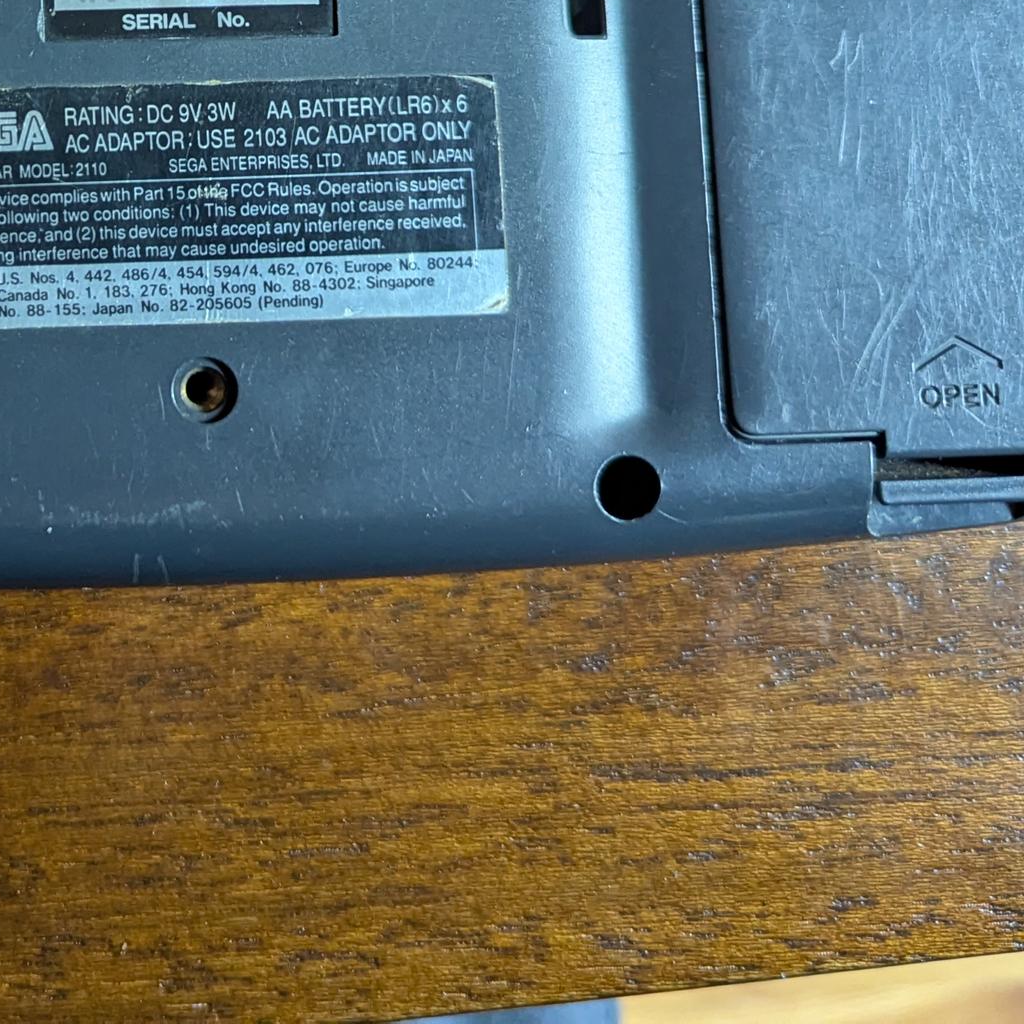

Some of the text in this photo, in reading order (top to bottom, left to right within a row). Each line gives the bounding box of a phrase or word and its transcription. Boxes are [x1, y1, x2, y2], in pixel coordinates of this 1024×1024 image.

[122, 11, 250, 30] SERIAL No.
[147, 104, 173, 123] DC
[179, 103, 201, 122] 9V
[208, 101, 236, 121] 3W
[267, 100, 292, 120] AA
[65, 134, 89, 153] AC
[197, 129, 236, 149] USE
[244, 128, 287, 147] 2103
[295, 126, 320, 145] AC
[326, 123, 416, 144] ADAPTOR
[422, 121, 471, 140] ONLY
[169, 153, 345, 172] SEGA ENTERPRISES, LTD.
[367, 149, 474, 165] MADE IN JAPAN
[30, 188, 98, 208] complies
[100, 187, 130, 202] with
[134, 186, 164, 200] Part
[168, 185, 185, 199] 15
[231, 182, 264, 197] FCC
[268, 181, 315, 197] Rules.
[318, 179, 393, 197] Operation
[396, 179, 407, 192] is
[410, 176, 465, 197] subject
[63, 209, 89, 222] two
[180, 205, 200, 221] (1)
[204, 203, 236, 217] This
[240, 202, 289, 216] device
[295, 200, 326, 217] may
[331, 200, 355, 213] not
[359, 199, 404, 212] cause
[408, 196, 465, 210] harmful
[44, 226, 73, 242] and
[76, 226, 96, 243] (2)
[99, 226, 126, 240] this
[129, 223, 178, 238] device
[182, 223, 218, 237] must
[221, 221, 270, 238] accept
[274, 221, 299, 237] any
[304, 217, 394, 233] interference
[19, 247, 108, 261] interference
[112, 244, 141, 259] that
[146, 245, 176, 260] may
[181, 242, 226, 256] cause
[231, 239, 305, 254] undesired
[309, 237, 385, 255] operation.
[31, 272, 59, 284] Nos.
[344, 261, 392, 274] Europe
[399, 259, 420, 270] No.
[57, 288, 79, 300] No.
[180, 284, 214, 297] Hong
[221, 282, 256, 296] Kong
[263, 280, 286, 293] No.
[366, 276, 435, 290] Singapore
[93, 303, 133, 315] Japan
[141, 301, 163, 313] No.
[170, 297, 252, 311] 82-205605
[258, 294, 323, 310] (Pending)
[919, 383, 1000, 408] OPEN
